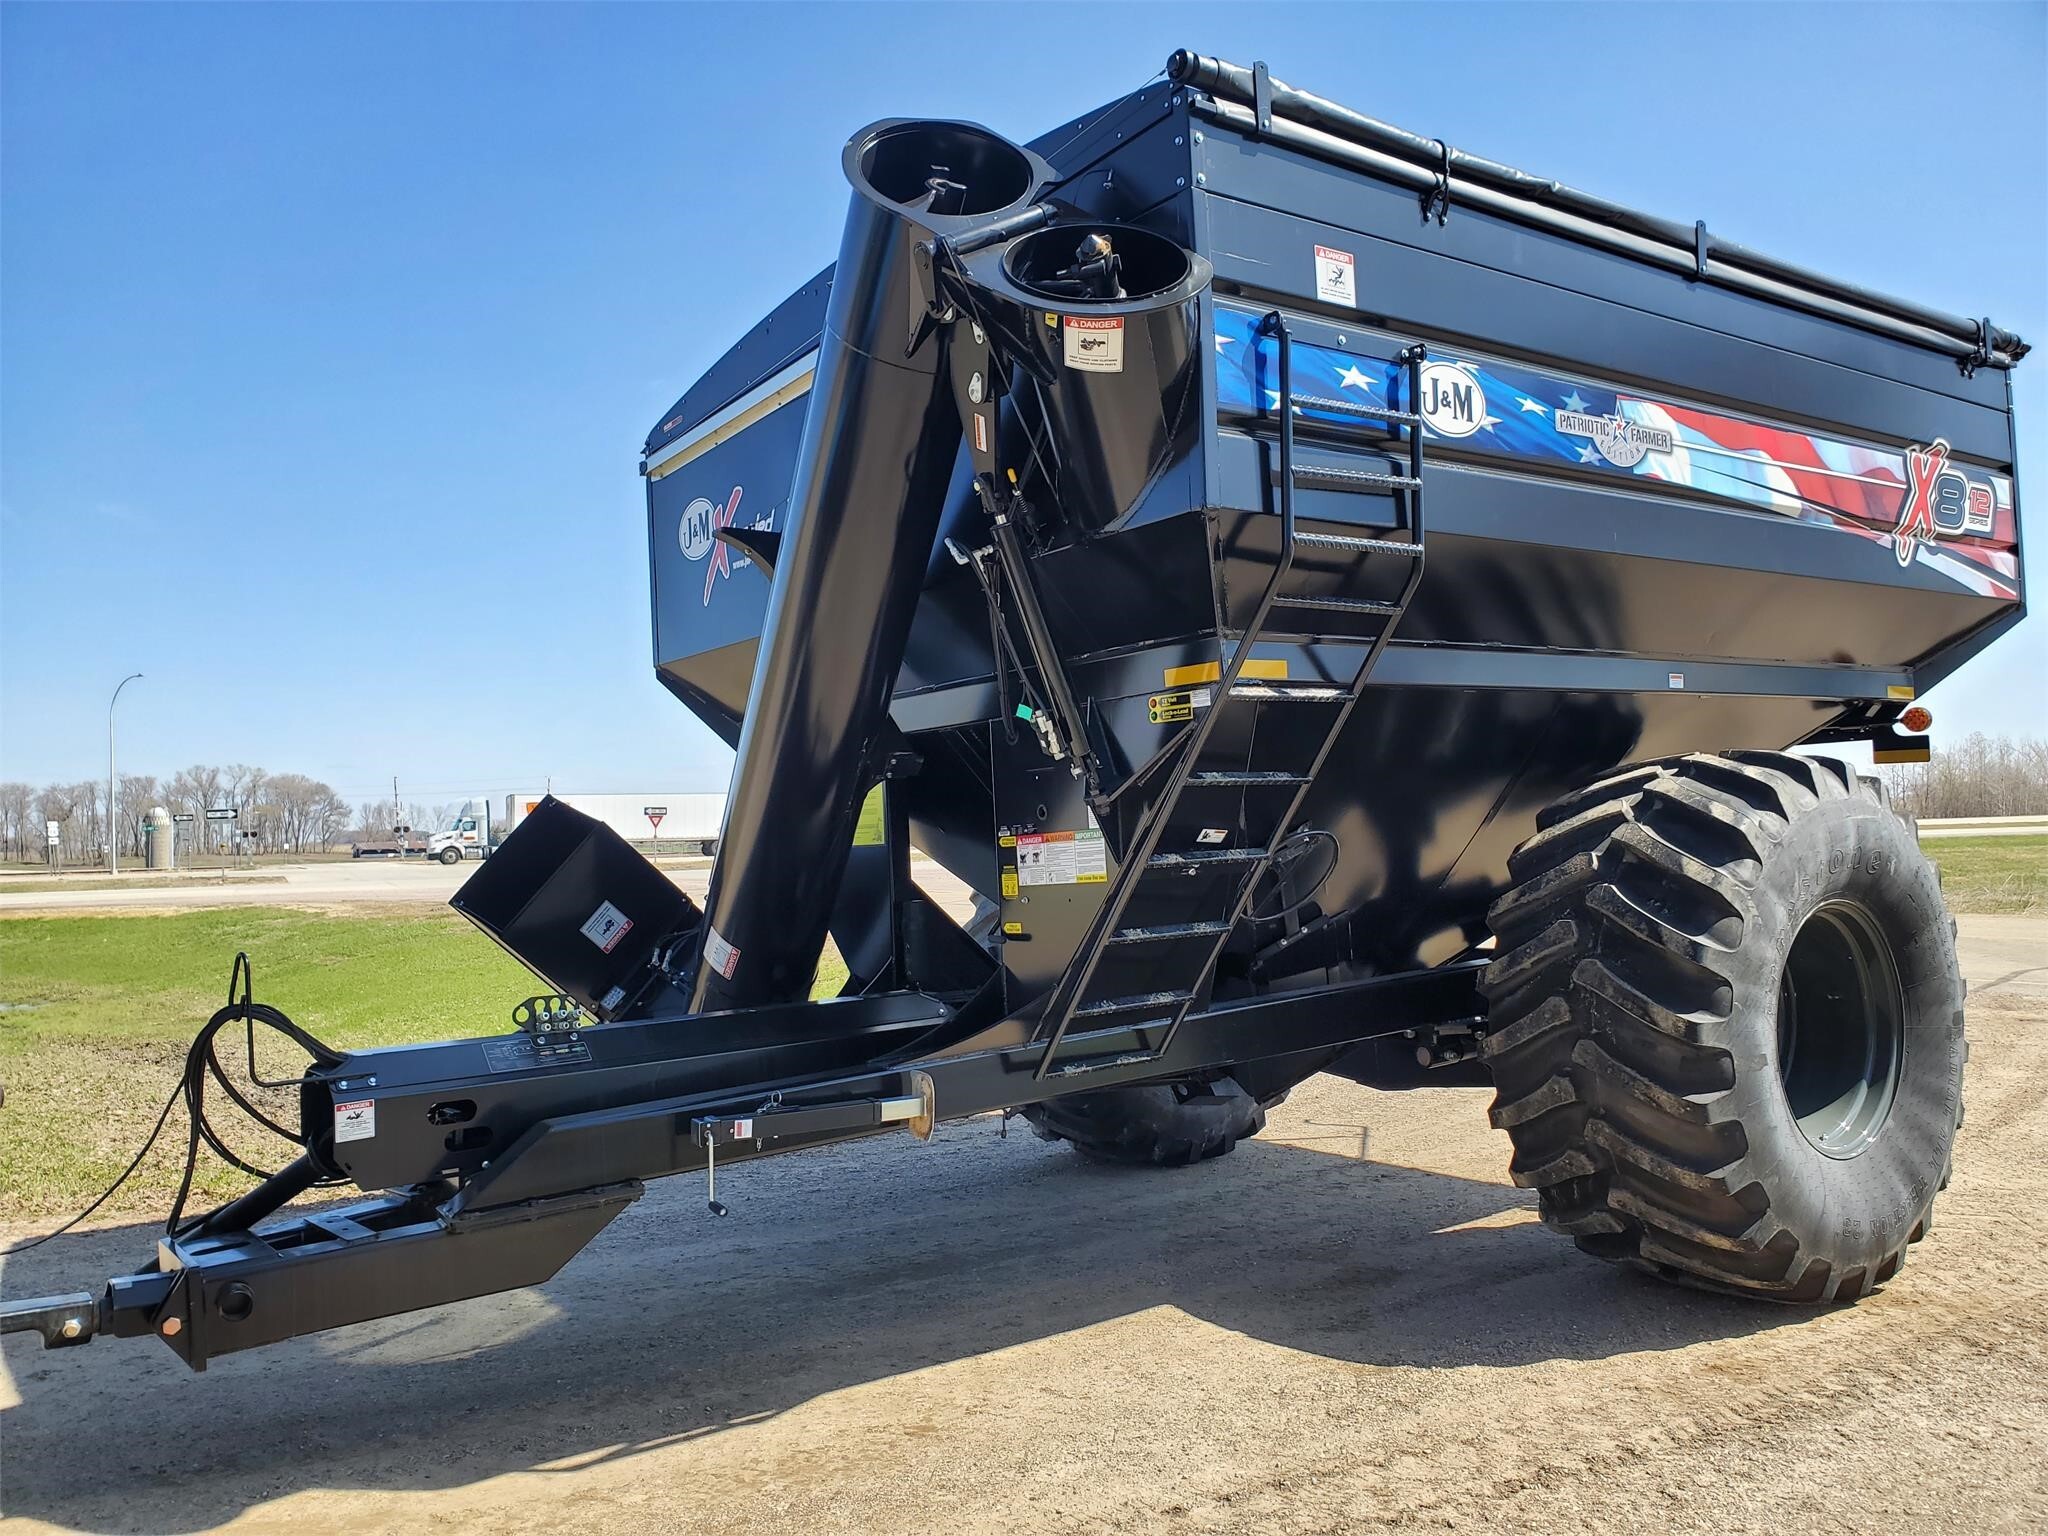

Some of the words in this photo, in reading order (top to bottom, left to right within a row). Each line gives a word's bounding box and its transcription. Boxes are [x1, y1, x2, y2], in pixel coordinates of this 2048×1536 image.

[1325, 250, 1350, 264] DANGER
[1080, 320, 1118, 329] DANGER
[1422, 377, 1473, 423] J&M
[1560, 413, 1610, 437] PATRIOTIC
[1631, 427, 1668, 448] FARMER
[1600, 440, 1640, 460] EDITION
[683, 508, 711, 550] J&M
[1021, 836, 1042, 845] DANGER
[723, 953, 738, 977] DANGER
[346, 1101, 370, 1110] DANGER
